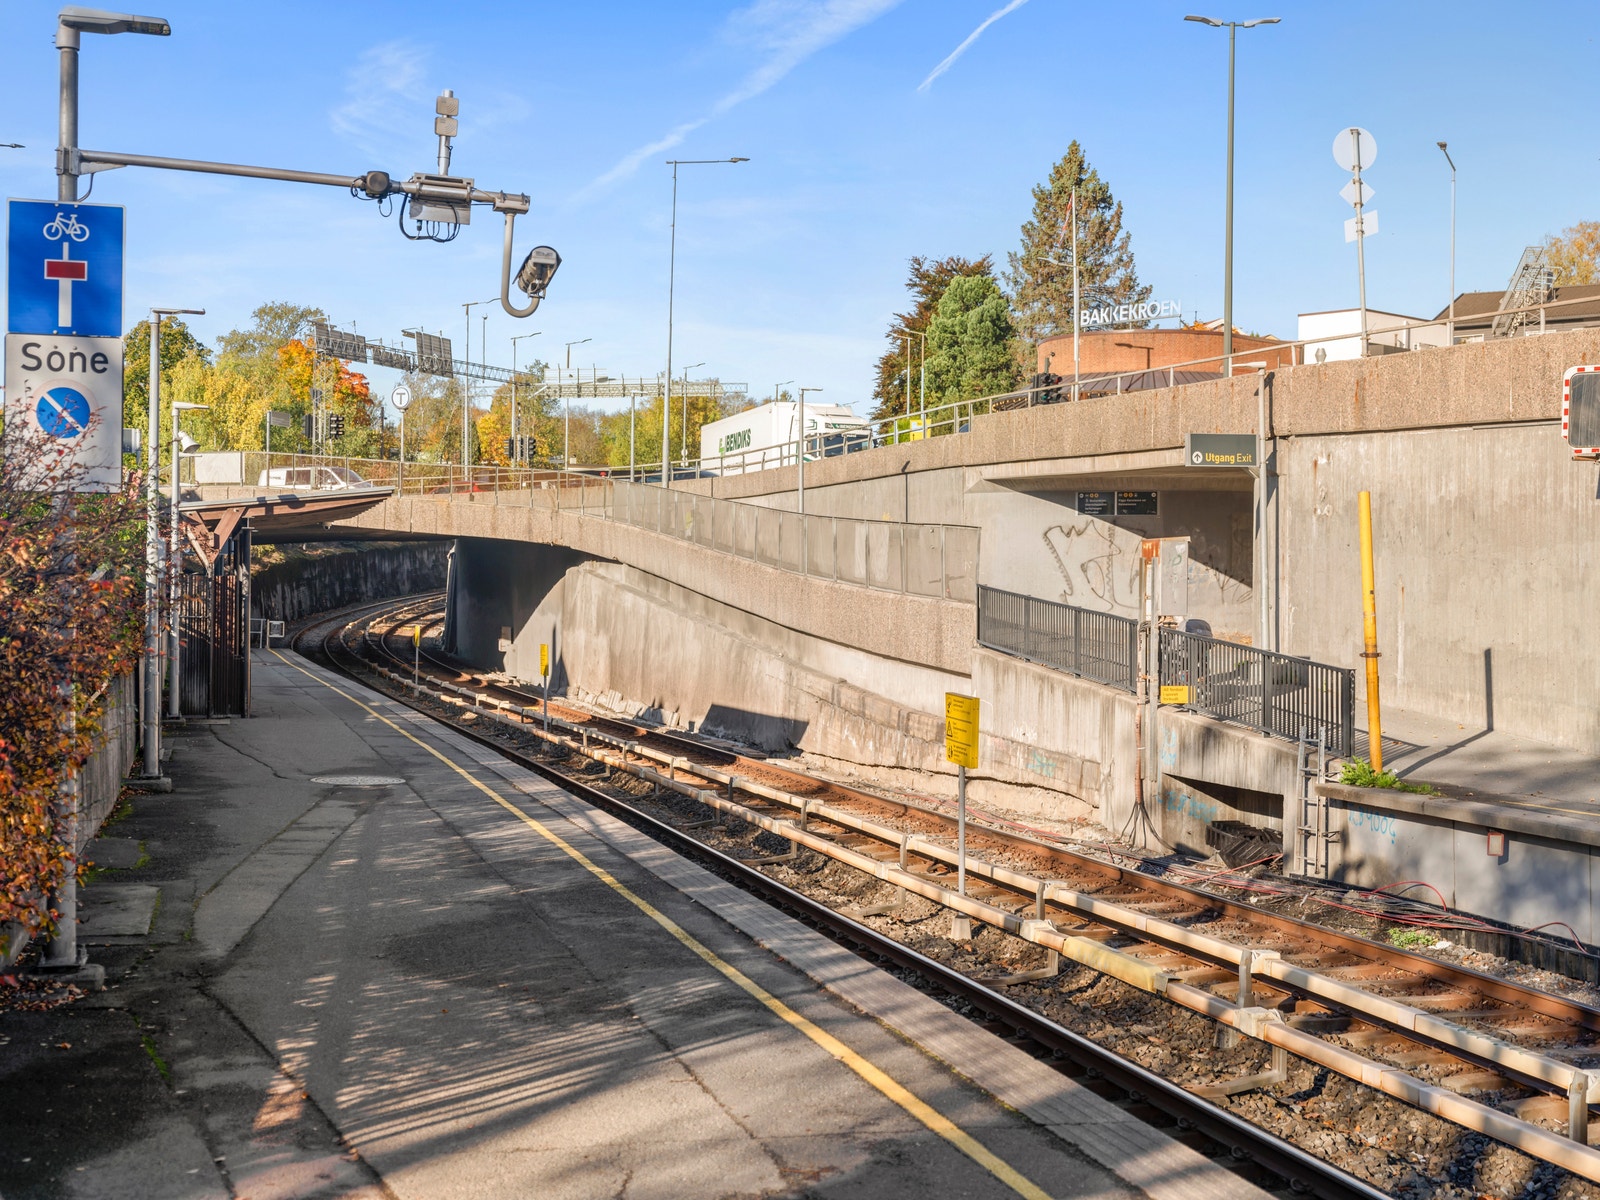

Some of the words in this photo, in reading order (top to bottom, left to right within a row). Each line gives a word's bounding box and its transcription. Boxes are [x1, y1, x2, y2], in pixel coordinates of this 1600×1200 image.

[1080, 300, 1181, 327] BAKKEKROEN
[21, 342, 109, 374] Sone
[396, 392, 406, 405] T
[725, 428, 751, 453] BENDIKS
[1205, 452, 1235, 464] Utgang
[1236, 453, 1252, 463] Exit
